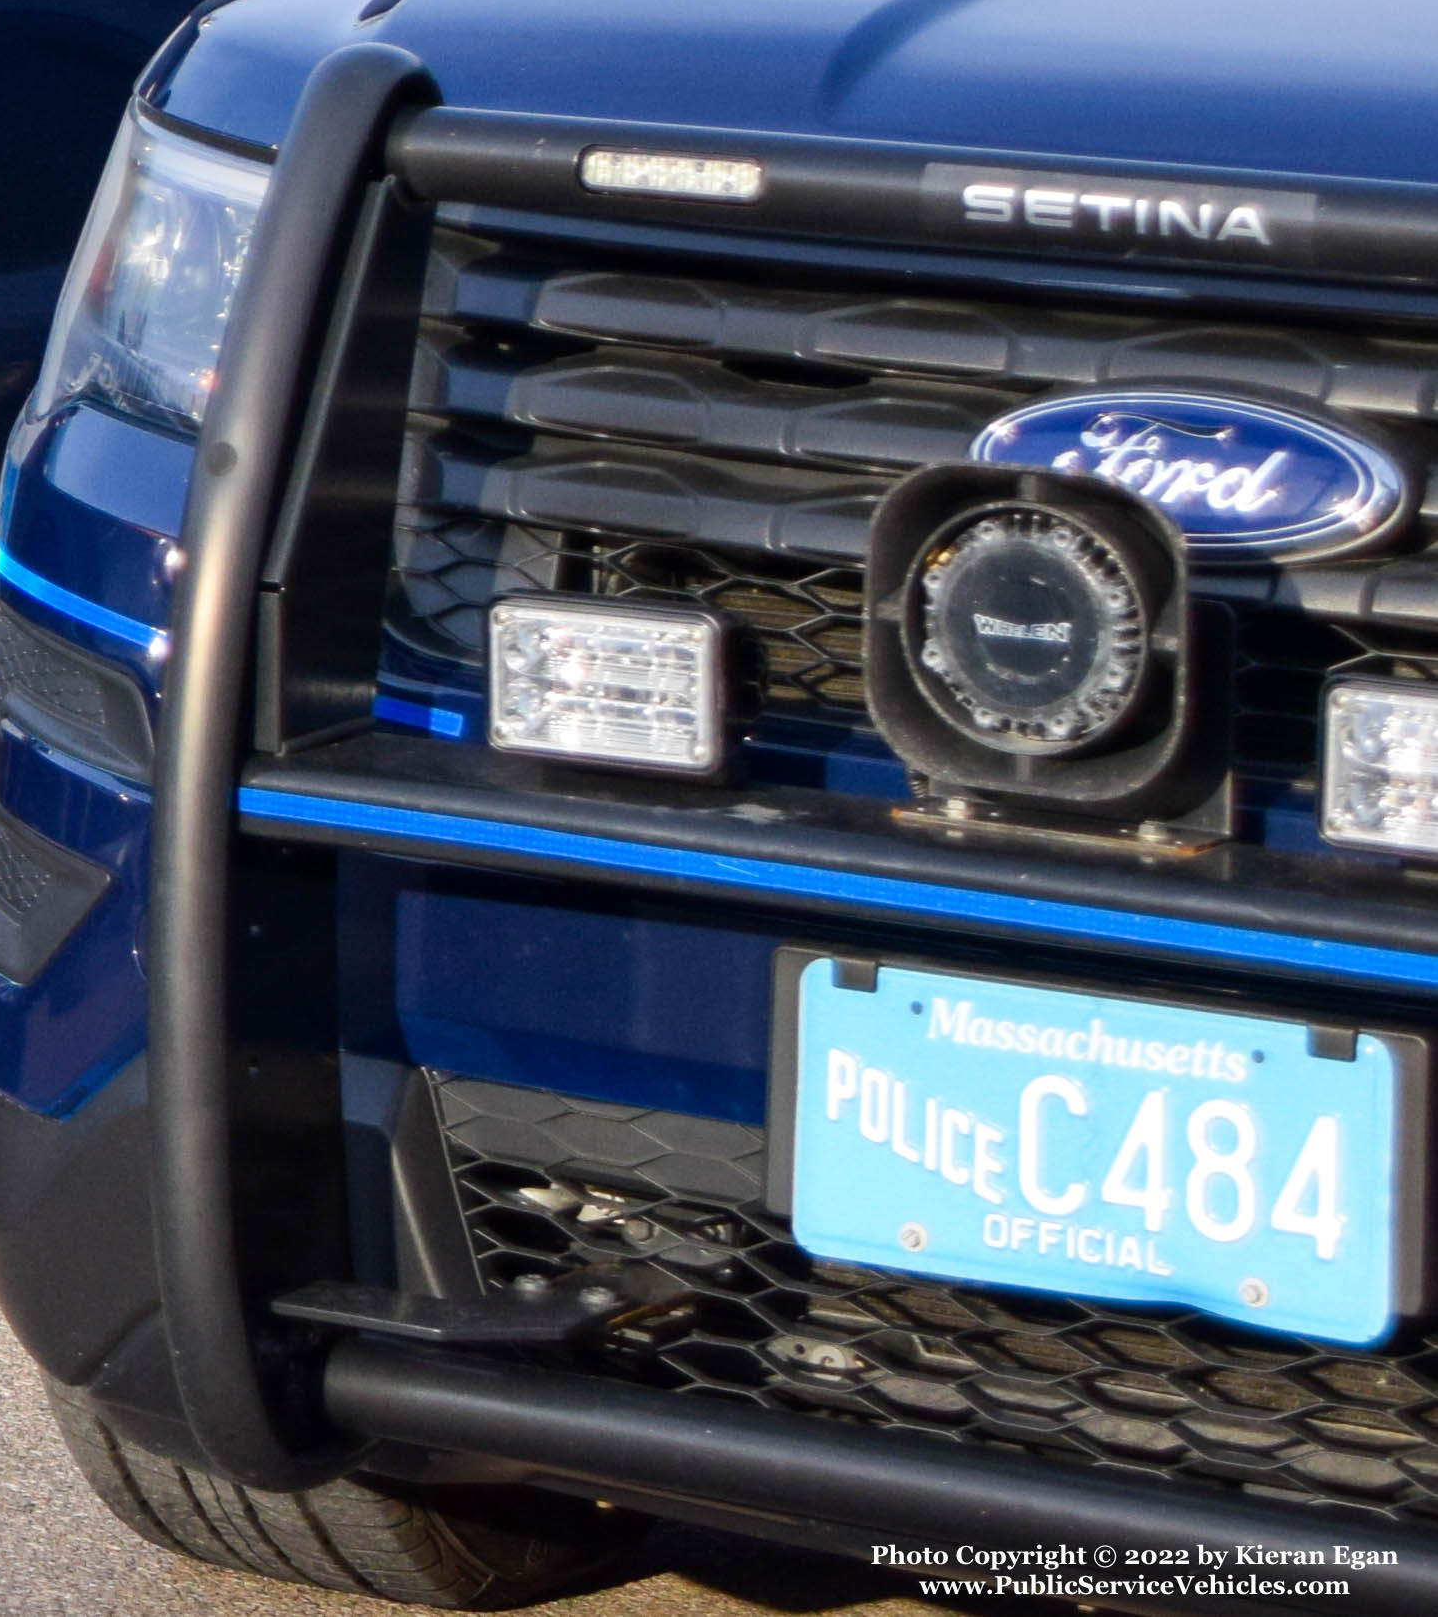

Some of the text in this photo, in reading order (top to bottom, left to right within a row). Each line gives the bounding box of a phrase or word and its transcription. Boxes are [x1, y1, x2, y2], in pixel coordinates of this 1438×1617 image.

[962, 184, 1272, 246] SETINA
[1051, 411, 1288, 512] Ford
[927, 995, 1248, 1083] Massachusetts
[825, 1047, 1348, 1262] POLICE C484
[982, 1211, 1175, 1278] OFFICIAL
